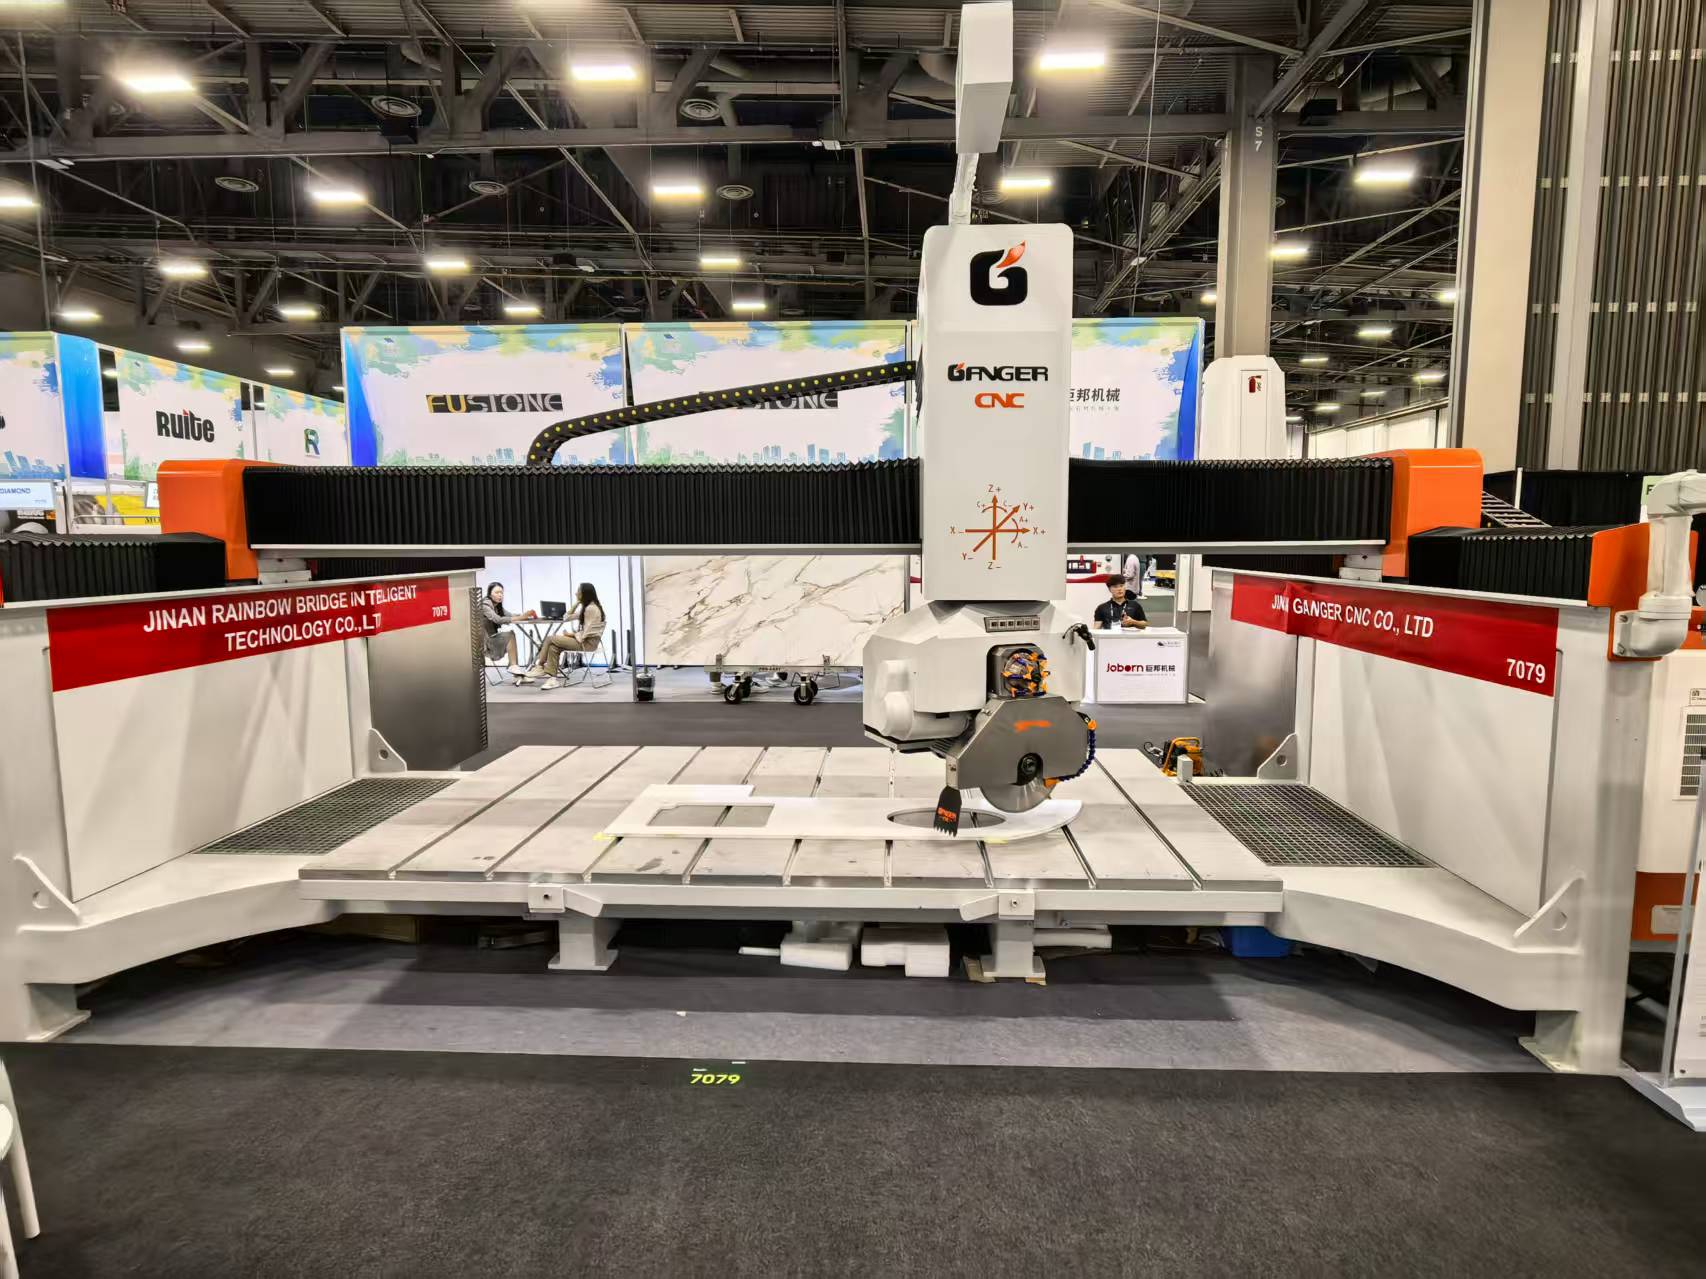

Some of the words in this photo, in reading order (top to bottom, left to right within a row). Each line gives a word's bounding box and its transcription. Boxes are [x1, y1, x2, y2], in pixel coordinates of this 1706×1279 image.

[947, 362, 1049, 381] GANGER
[974, 392, 1025, 408] CNC
[156, 408, 215, 443] Ruite
[304, 428, 321, 455] R
[143, 605, 207, 632] JINAN
[211, 597, 292, 624] RAINBOW
[296, 592, 348, 614] BRIDGE
[431, 605, 448, 617] 7079
[1292, 597, 1343, 622] GANGER
[1345, 605, 1371, 627] CNC
[1373, 609, 1400, 636] CO.,
[1404, 614, 1434, 638] LTD
[224, 618, 332, 652] TECHNOLOGY
[1506, 658, 1546, 684] 7079
[690, 1073, 741, 1085] 7079
